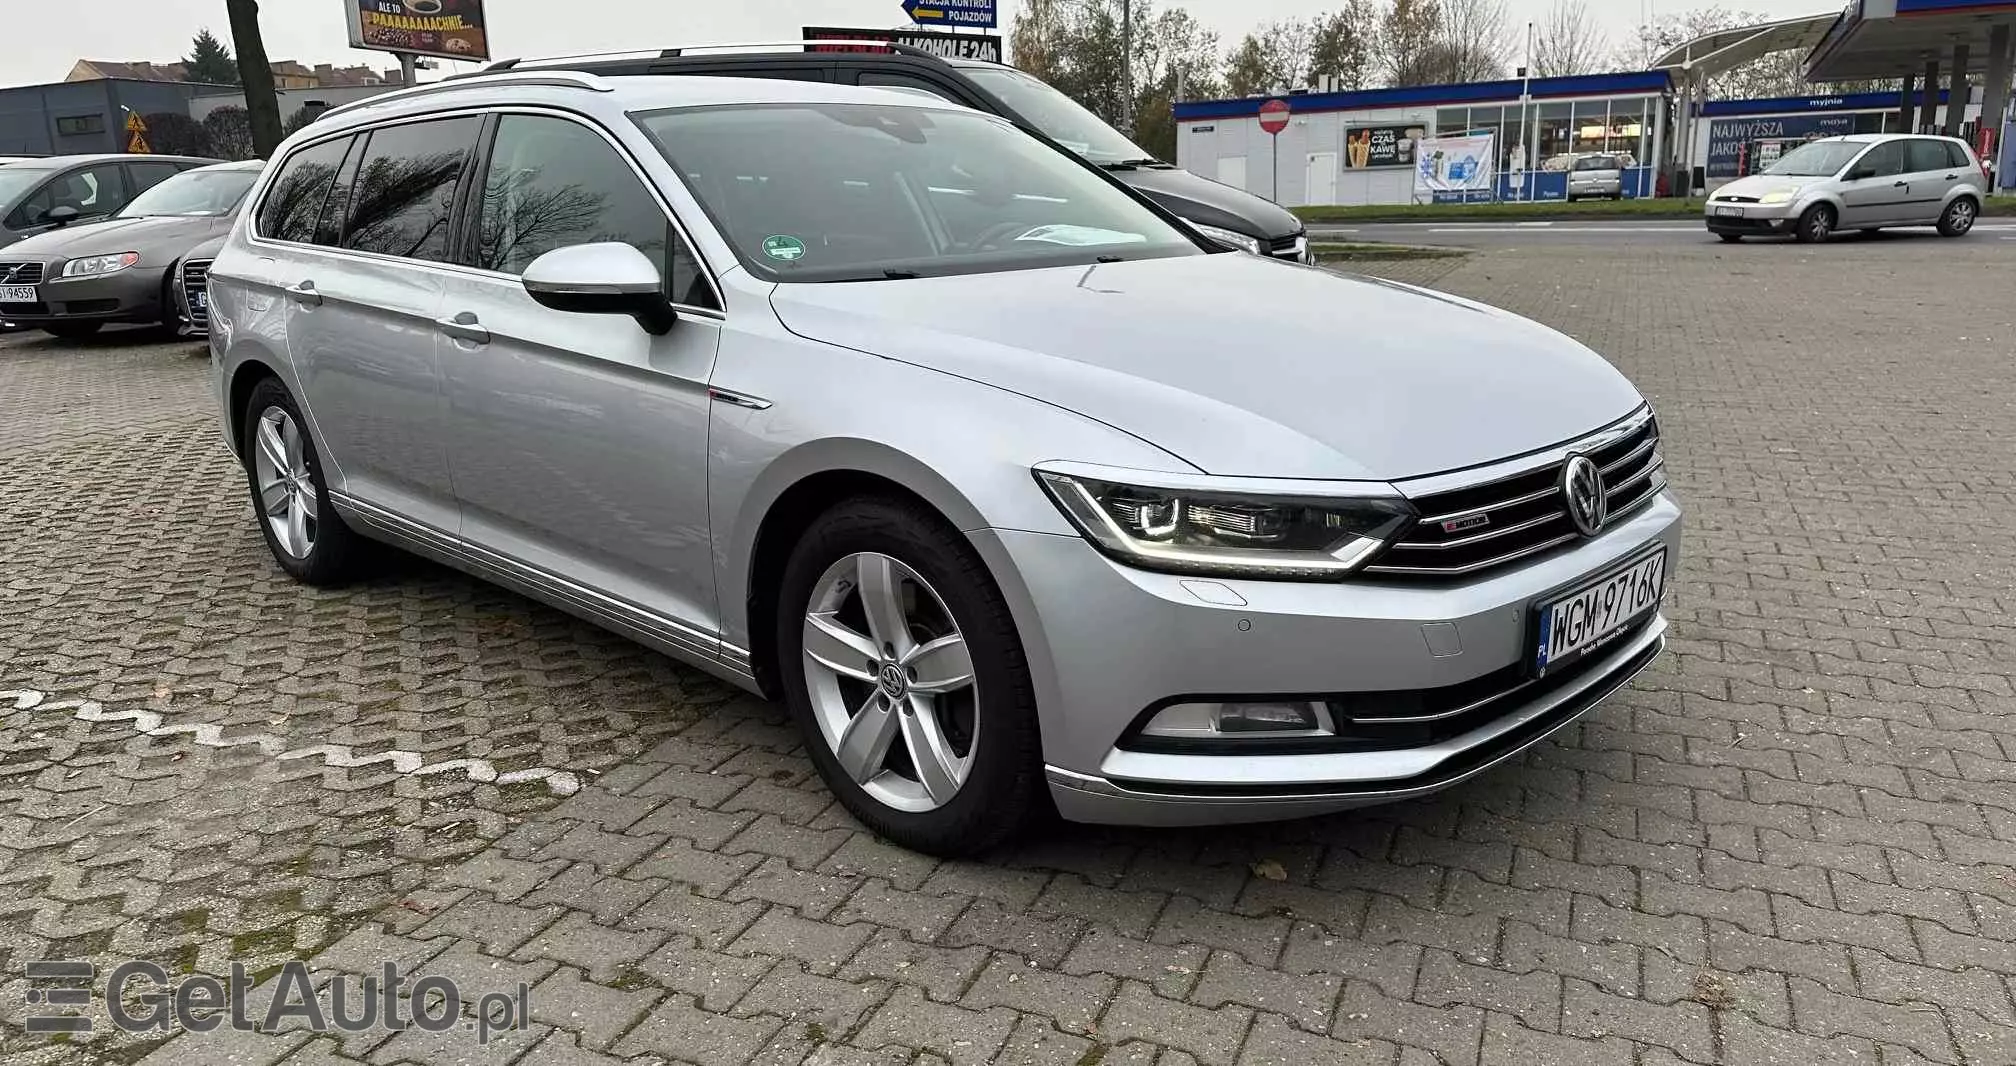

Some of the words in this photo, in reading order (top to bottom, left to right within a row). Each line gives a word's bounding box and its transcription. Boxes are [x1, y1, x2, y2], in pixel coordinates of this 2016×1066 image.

[379, 2, 393, 12] ALE
[392, 3, 401, 14] TO
[948, 10, 992, 22] POJAZDÓW
[970, 40, 998, 62] 24h
[1809, 97, 1843, 107] myjnia
[1712, 119, 1784, 138] NAJWYŻSZA
[7, 287, 34, 299] 94559
[1551, 589, 1600, 656] WGM
[1601, 556, 1662, 630] 9716K
[1537, 643, 1547, 658] PL
